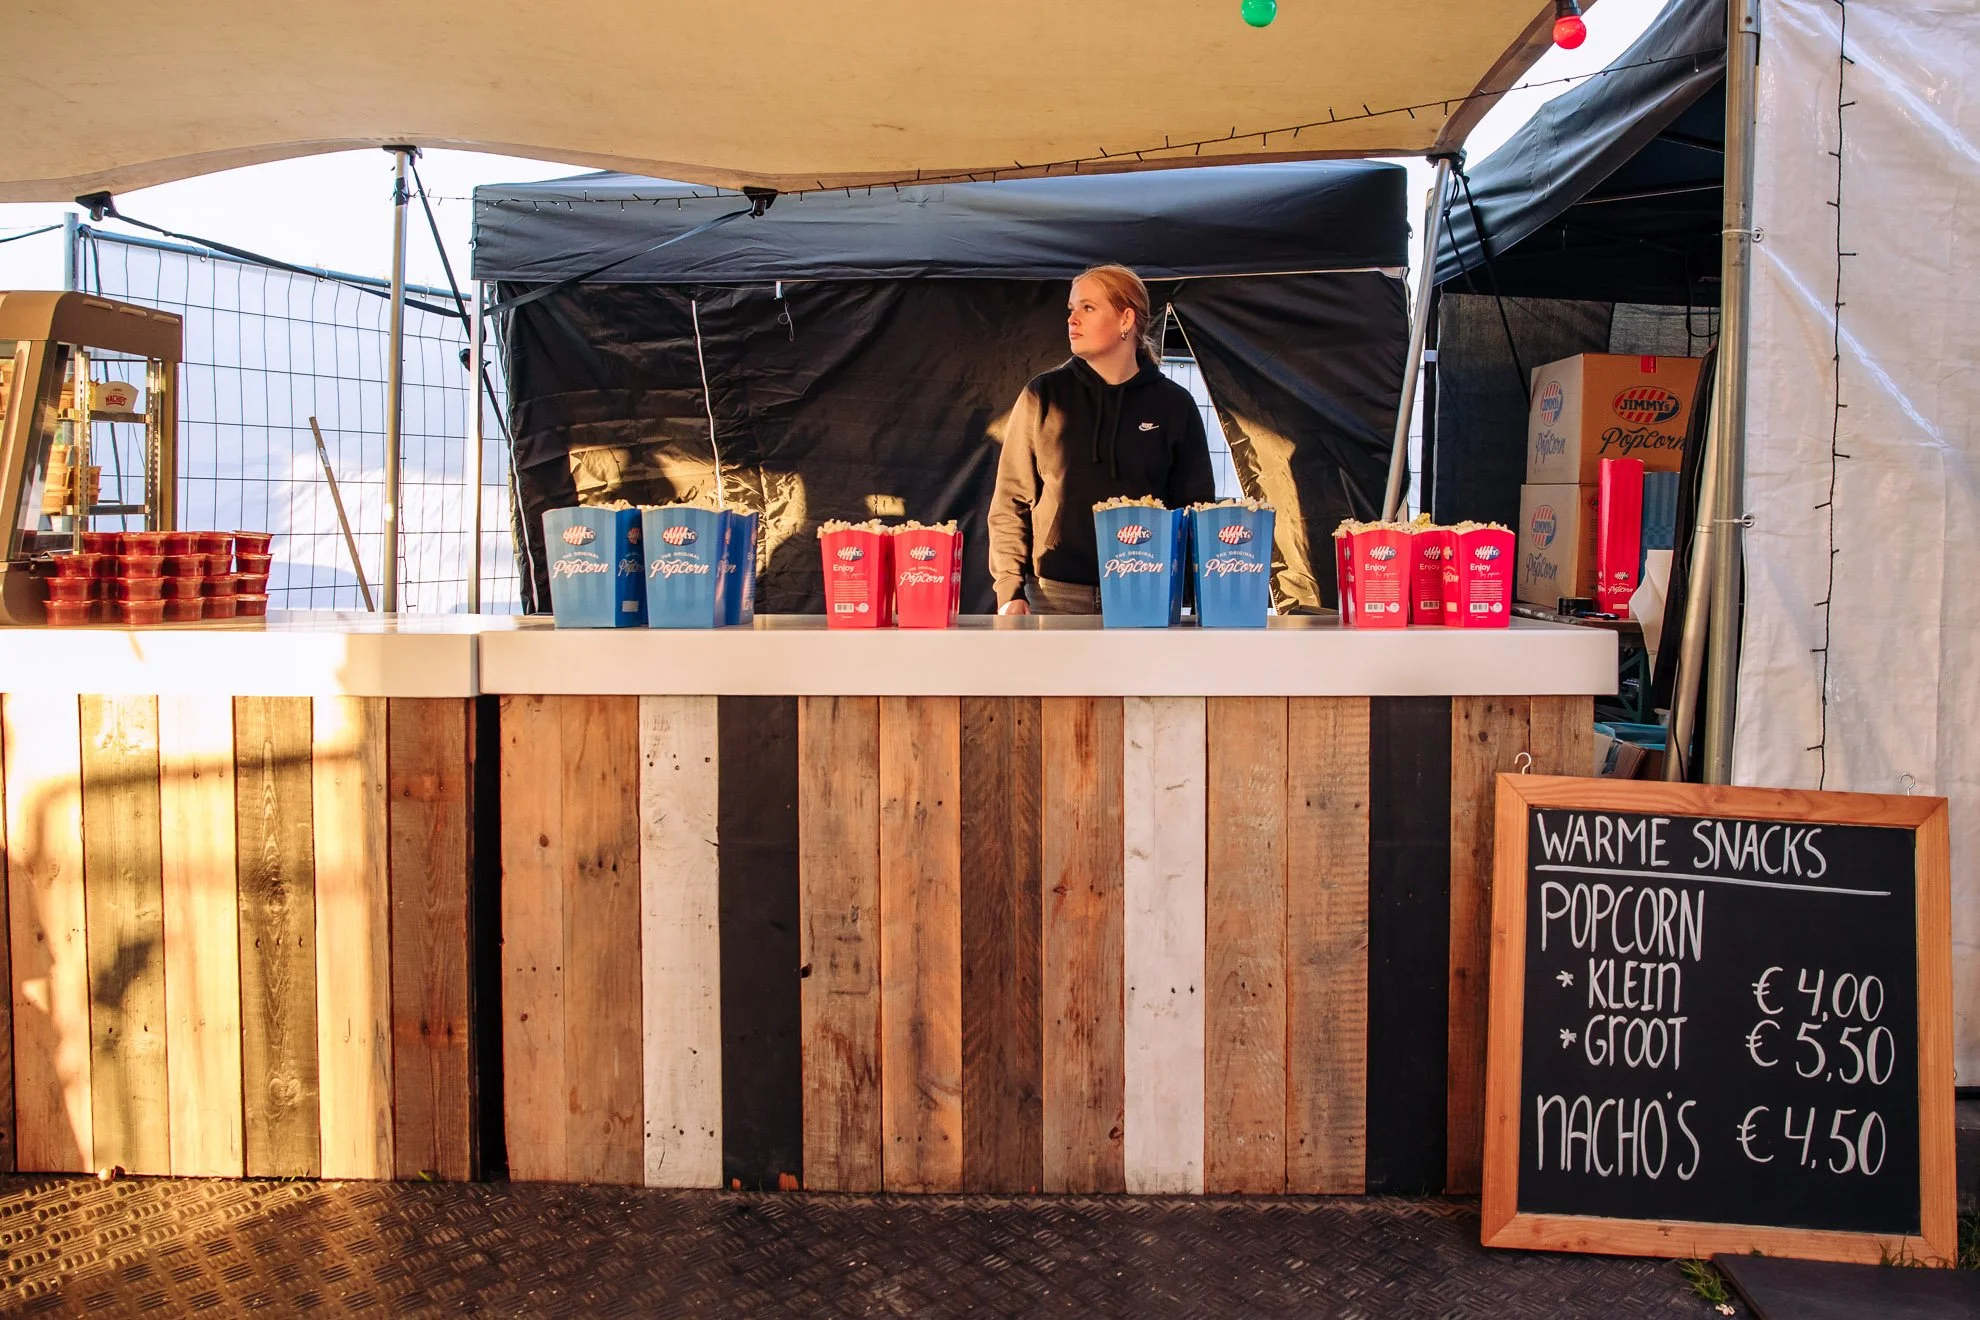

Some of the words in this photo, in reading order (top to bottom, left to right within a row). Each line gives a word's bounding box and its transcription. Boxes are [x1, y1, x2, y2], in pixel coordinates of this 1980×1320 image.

[832, 563, 855, 573] Enjoy
[1364, 563, 1387, 572] Enjoy
[1419, 563, 1440, 571] Enjoy
[1469, 563, 1491, 572] Enjoy
[1537, 812, 1670, 866] WARME
[1693, 820, 1827, 878] SNACKS
[1541, 881, 1704, 961] POPCORN
[1797, 968, 1884, 1022] 4,00
[1795, 1022, 1895, 1085] 5,50
[1783, 1106, 1886, 1176] 4,50
